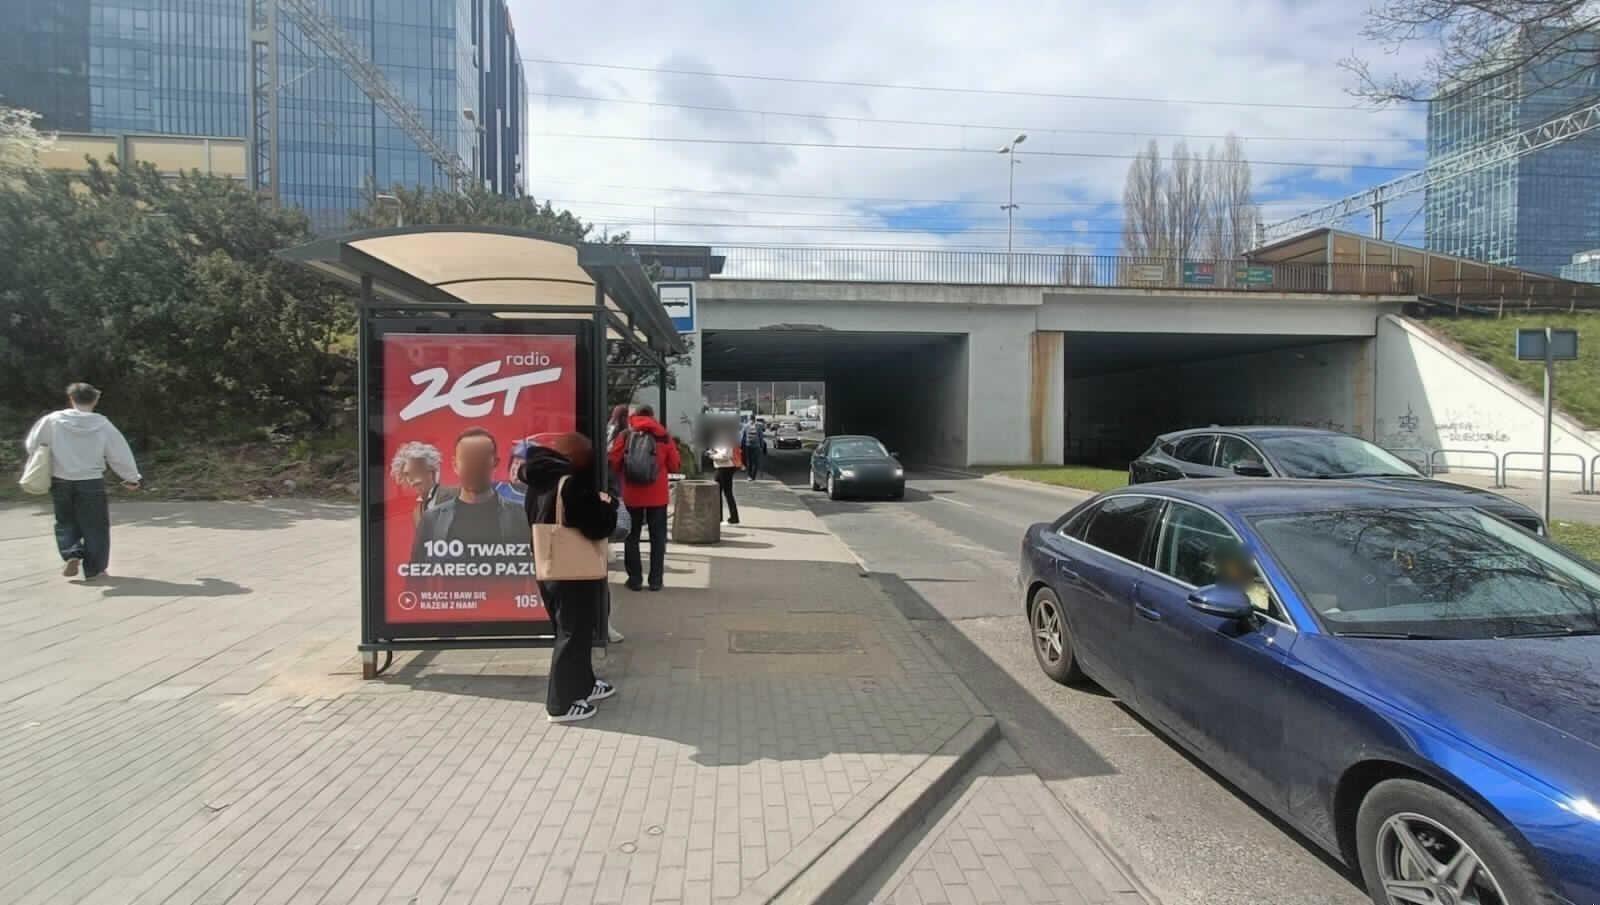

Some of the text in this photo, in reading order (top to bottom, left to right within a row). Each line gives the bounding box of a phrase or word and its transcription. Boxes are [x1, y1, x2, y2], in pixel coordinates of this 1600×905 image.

[506, 352, 550, 366] radio
[400, 360, 562, 421] ZET
[424, 539, 464, 557] 100
[397, 563, 492, 577] CEZAREGO
[454, 591, 473, 600] BAW
[514, 594, 538, 608] 105
[420, 600, 449, 609] RAZEM
